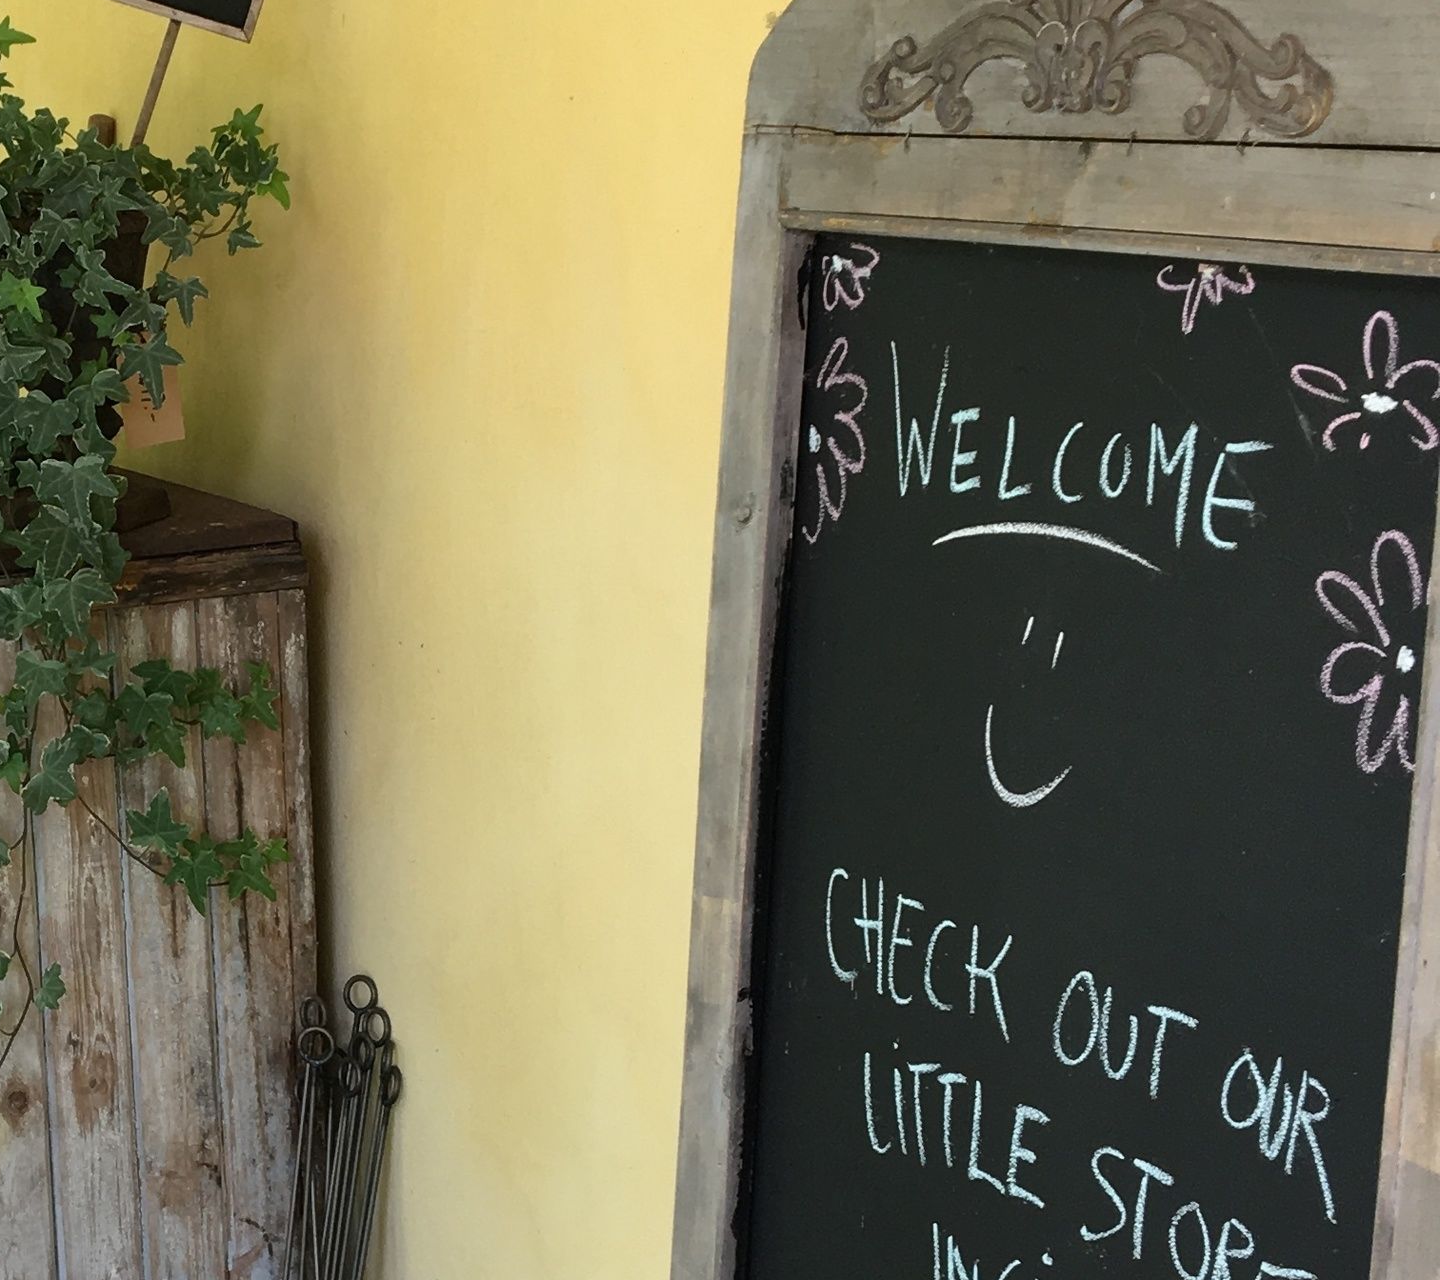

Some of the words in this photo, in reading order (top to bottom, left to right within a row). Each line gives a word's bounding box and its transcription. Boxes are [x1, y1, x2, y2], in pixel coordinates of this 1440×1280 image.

[890, 340, 1275, 550] WELCOME
[825, 868, 1013, 1043] CHECK
[1053, 970, 1199, 1099] OUT
[1220, 1047, 1338, 1224] OUR
